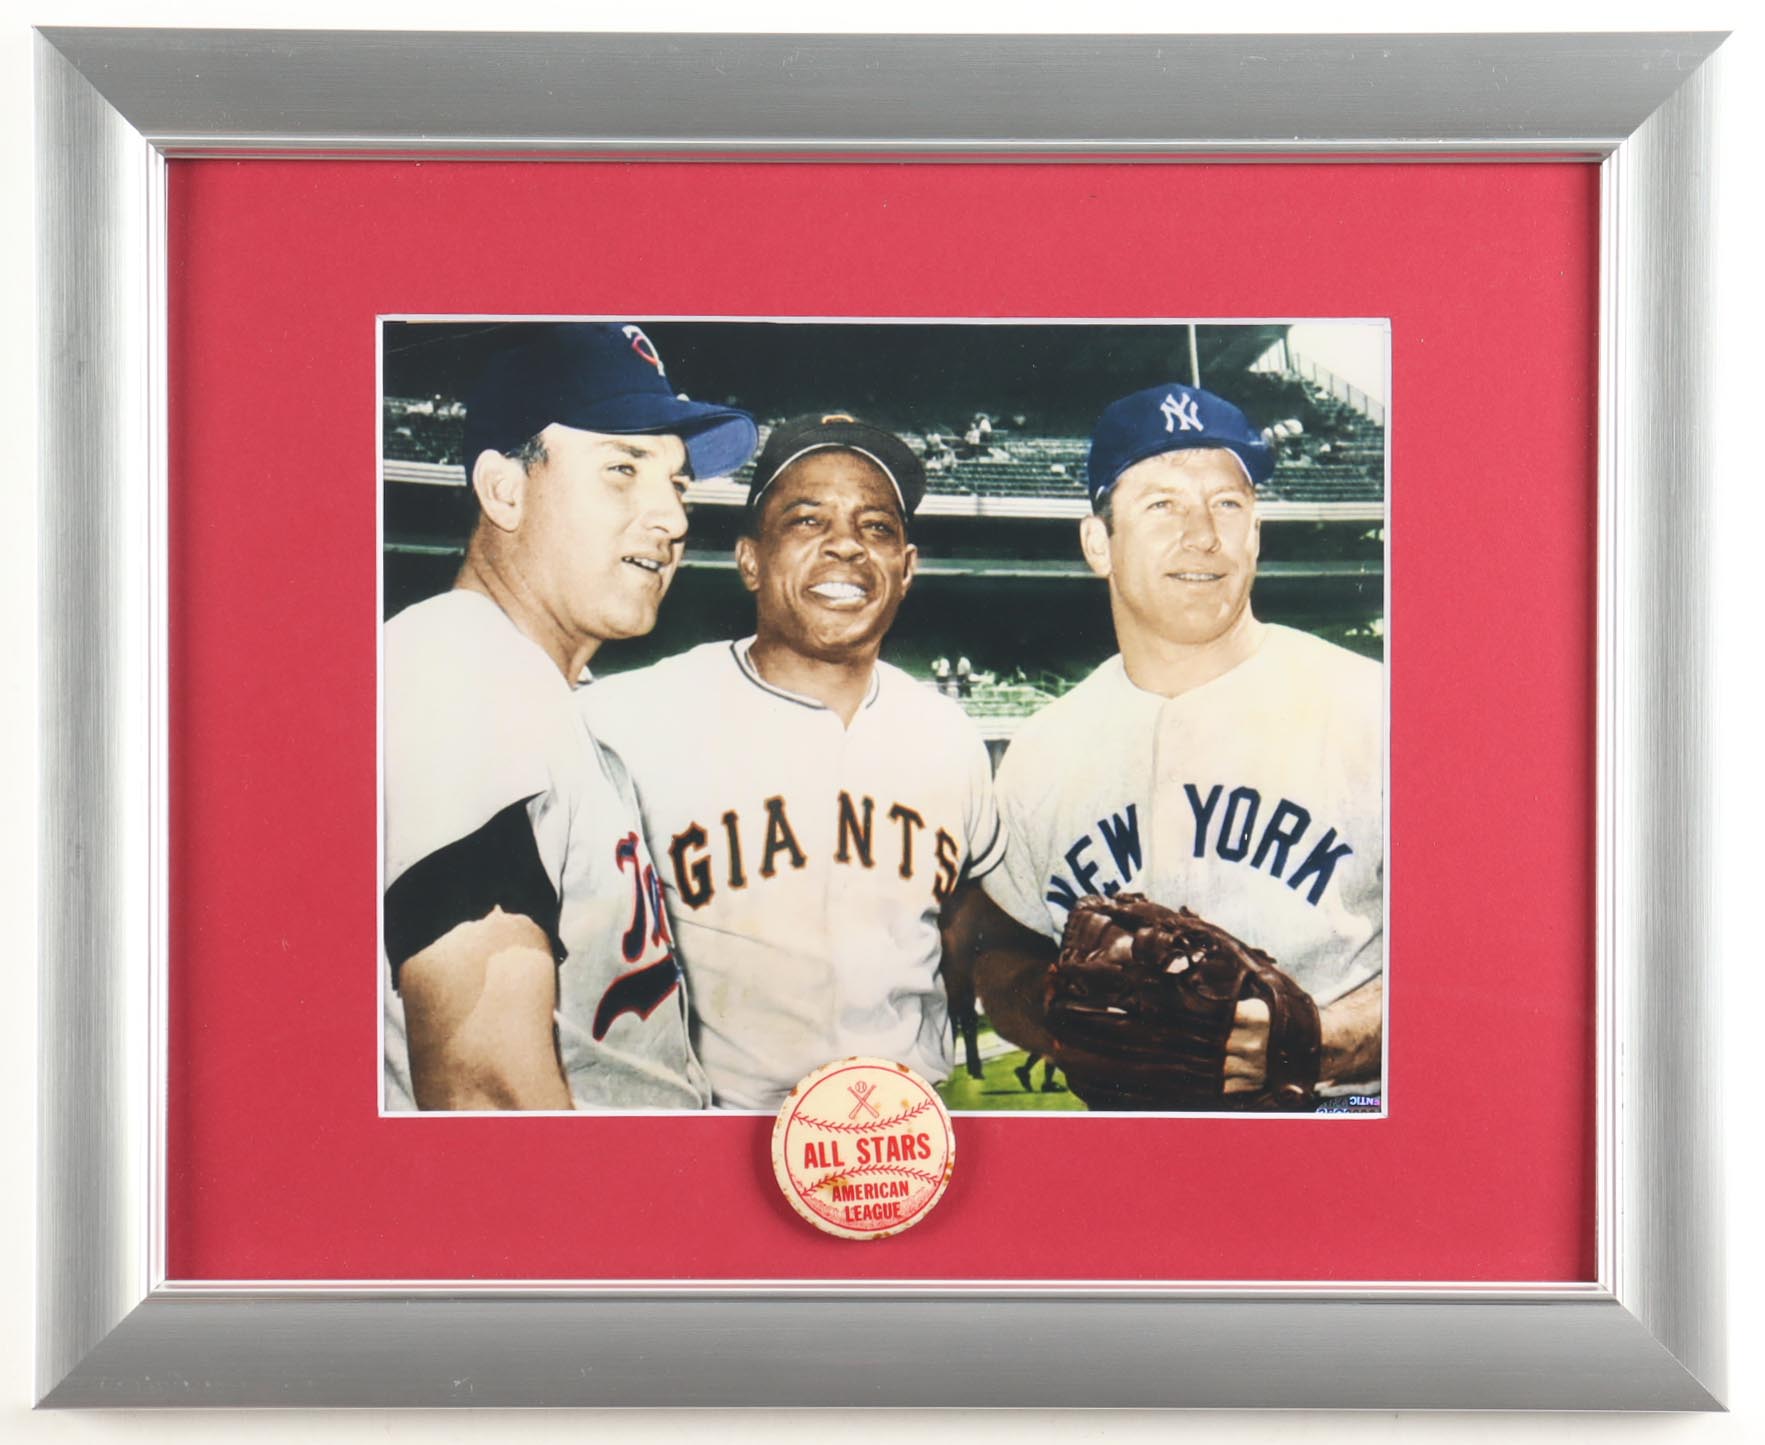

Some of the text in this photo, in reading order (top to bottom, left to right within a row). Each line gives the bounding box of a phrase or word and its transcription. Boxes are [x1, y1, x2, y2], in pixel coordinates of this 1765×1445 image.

[1160, 392, 1204, 433] NY
[668, 789, 960, 910] GIANTS
[1183, 783, 1354, 907] YORK
[804, 1132, 931, 1169] ALL STARS
[832, 1180, 909, 1202] AMERICAN
[845, 1201, 902, 1222] LEAGUE
